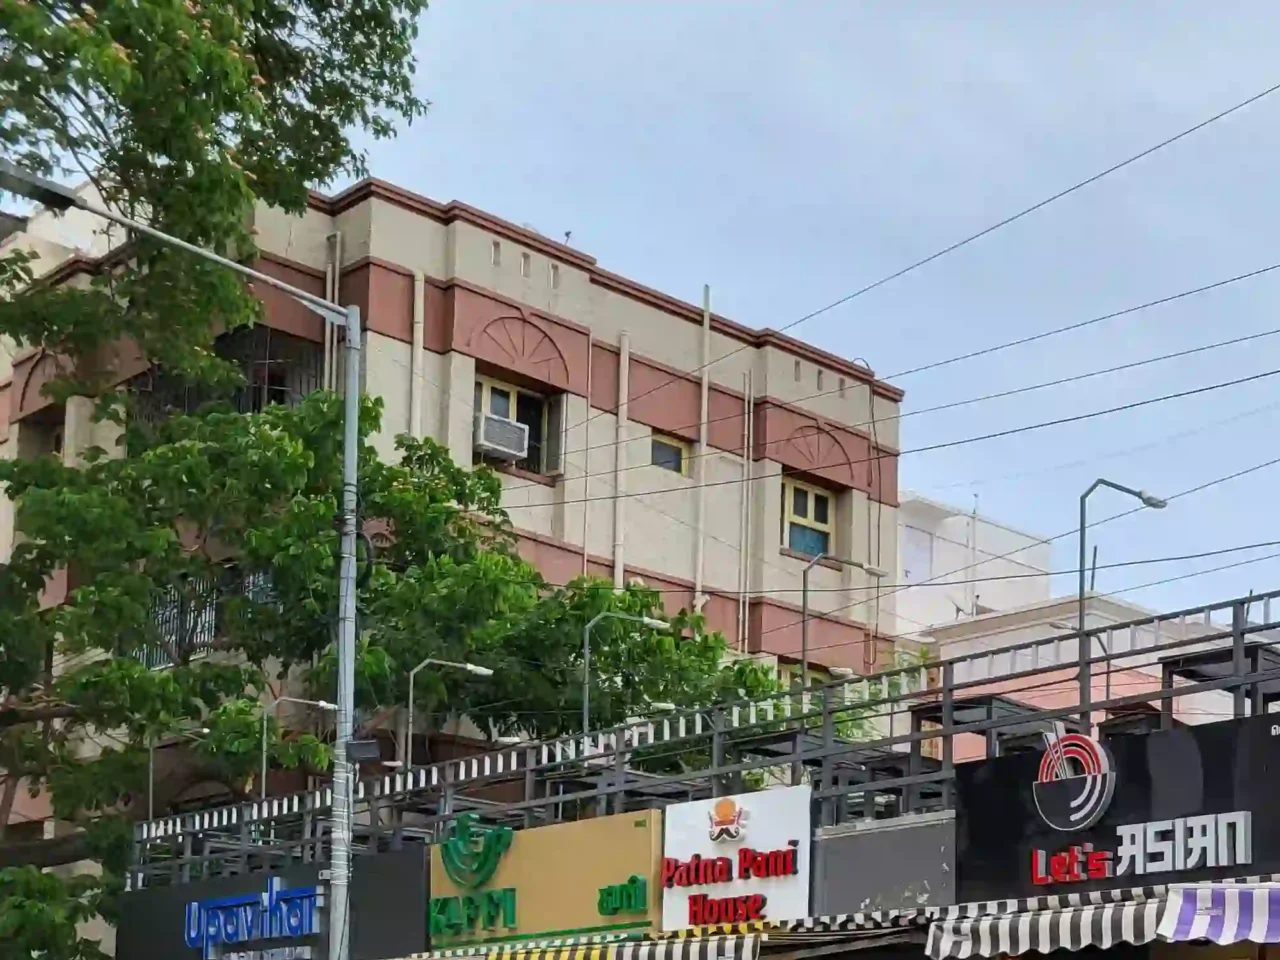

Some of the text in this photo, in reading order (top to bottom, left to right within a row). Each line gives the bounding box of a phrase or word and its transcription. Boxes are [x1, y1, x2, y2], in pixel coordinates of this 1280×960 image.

[661, 840, 799, 889] Patna Pani
[1032, 811, 1252, 885] Let's ASIAN
[185, 877, 324, 960] Upavihar
[688, 893, 768, 926] House
